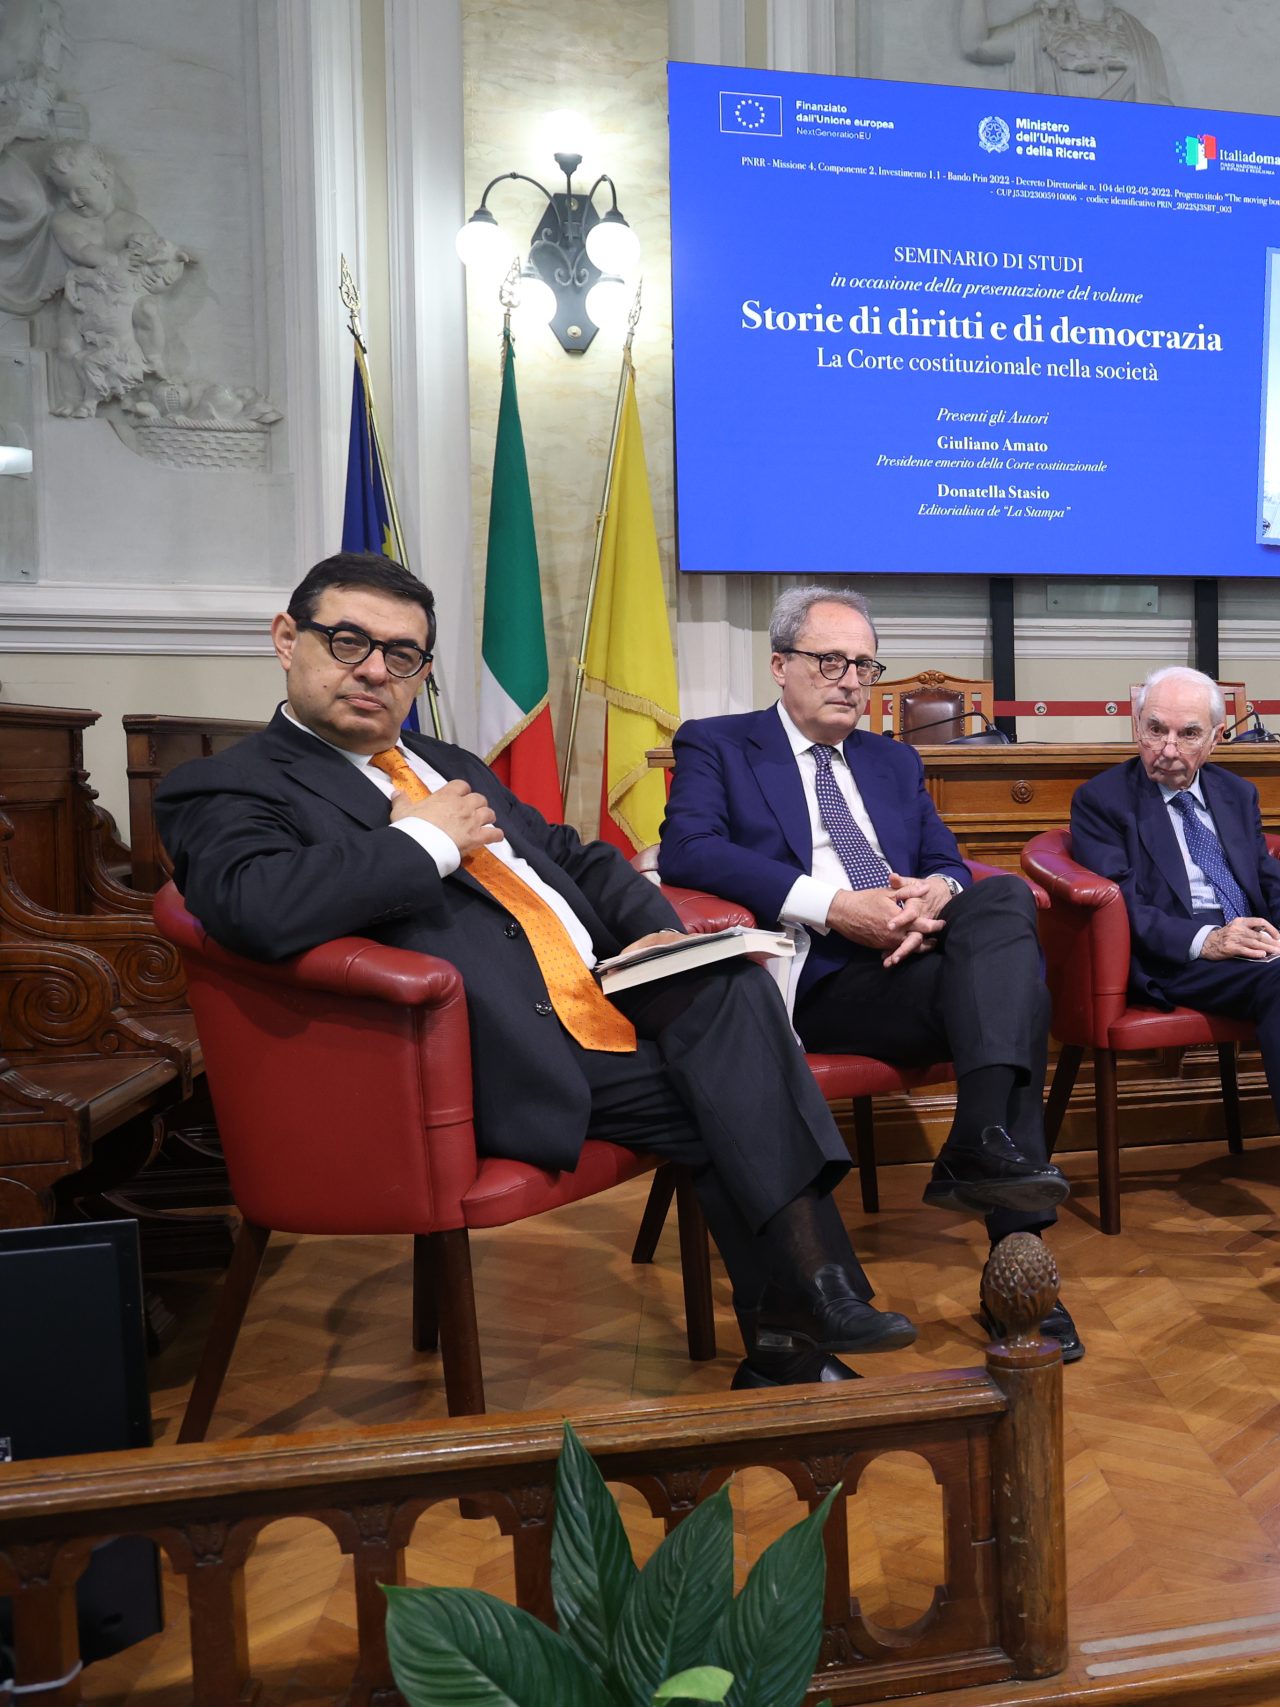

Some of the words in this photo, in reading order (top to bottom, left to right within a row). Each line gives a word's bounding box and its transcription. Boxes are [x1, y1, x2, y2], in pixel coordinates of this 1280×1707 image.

[796, 100, 847, 113] Finanziato
[796, 113, 851, 126] dall'Unione
[854, 118, 894, 130] europea
[1016, 118, 1069, 132] Ministero
[797, 126, 871, 140] NextGenerationEU
[1016, 130, 1096, 148] dell'Università
[1016, 145, 1023, 155] e
[1026, 144, 1053, 157] della
[1056, 146, 1095, 161] Ricerca
[741, 156, 766, 167] PNRR
[772, 158, 806, 170] Missione
[818, 162, 868, 175] Componente
[878, 166, 927, 178] Investimento
[929, 170, 941, 180] 1.1
[947, 171, 971, 182] Bando
[972, 173, 988, 183] Prin
[989, 174, 1010, 185] 2022
[1015, 176, 1046, 187] Decreto
[1046, 178, 1088, 190] Direttoriale
[1098, 183, 1113, 192] 104
[1114, 184, 1125, 195] del
[1126, 184, 1173, 197] 02-02-2022.
[1174, 188, 1204, 200] Progetto
[1204, 192, 1223, 201] titolo
[1243, 195, 1268, 207] moving
[1086, 194, 1109, 204] codice
[1111, 195, 1156, 207] identificativo
[895, 246, 998, 267] SEMINARIO
[1003, 252, 1023, 269] DI
[1029, 254, 1083, 273] STUDI
[830, 272, 847, 287] in
[849, 275, 922, 291] occasione
[925, 276, 961, 293] della
[962, 283, 1066, 299] presentazione
[1068, 284, 1089, 300] del
[1091, 286, 1143, 304] volume
[742, 299, 843, 333] Storie
[849, 305, 882, 335] di
[888, 307, 984, 339] diritti
[990, 321, 1007, 341] e
[1014, 313, 1044, 342] di
[1050, 315, 1223, 352] democrazia
[817, 346, 843, 368] La
[848, 348, 903, 370] Corte
[909, 353, 1041, 376] costituzionale
[1047, 358, 1091, 378] nella
[1096, 361, 1158, 381] società
[937, 407, 988, 422] Presenti
[989, 409, 1006, 426] gli
[1008, 410, 1049, 424] Autori
[937, 435, 999, 450] Giuliano
[1002, 438, 1048, 452] Amato
[876, 454, 933, 467] Presidente
[935, 457, 974, 468] emerito
[977, 456, 1003, 469] della
[1006, 457, 1034, 470] Corte
[1036, 459, 1107, 472] costituzionale
[938, 483, 1006, 498] Donatella
[1009, 485, 1049, 499] Stasio
[918, 503, 985, 516] Editorialista
[987, 504, 1000, 516] de
